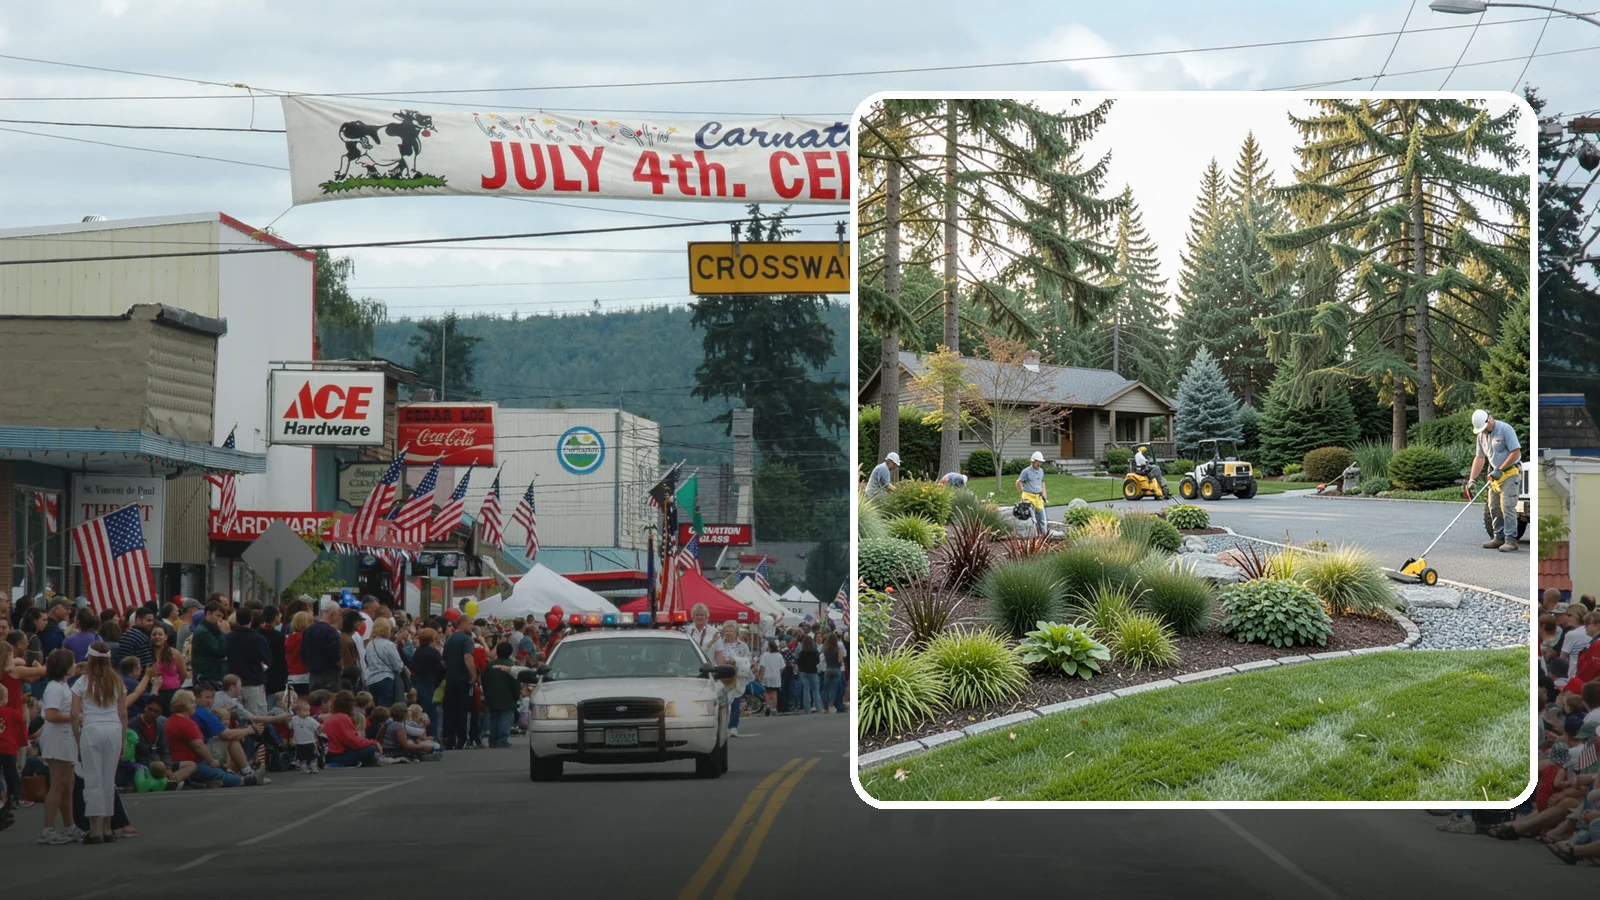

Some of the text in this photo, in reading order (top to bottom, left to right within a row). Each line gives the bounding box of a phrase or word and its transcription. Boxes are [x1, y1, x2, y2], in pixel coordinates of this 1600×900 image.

[481, 141, 605, 193] JULY
[632, 150, 746, 198] 4th.
[697, 254, 850, 279] CROSSWA
[283, 380, 373, 420] ACE
[406, 409, 452, 422] CEDAR
[284, 421, 370, 436] Hardware
[416, 428, 476, 447] Coca-Cola
[354, 467, 387, 483] Simpl
[83, 485, 155, 495] St. Vincent de Paul
[81, 503, 153, 522] THT
[212, 516, 330, 536] HARDARE
[688, 526, 741, 535] CRNATION
[699, 535, 730, 543] GLASS
